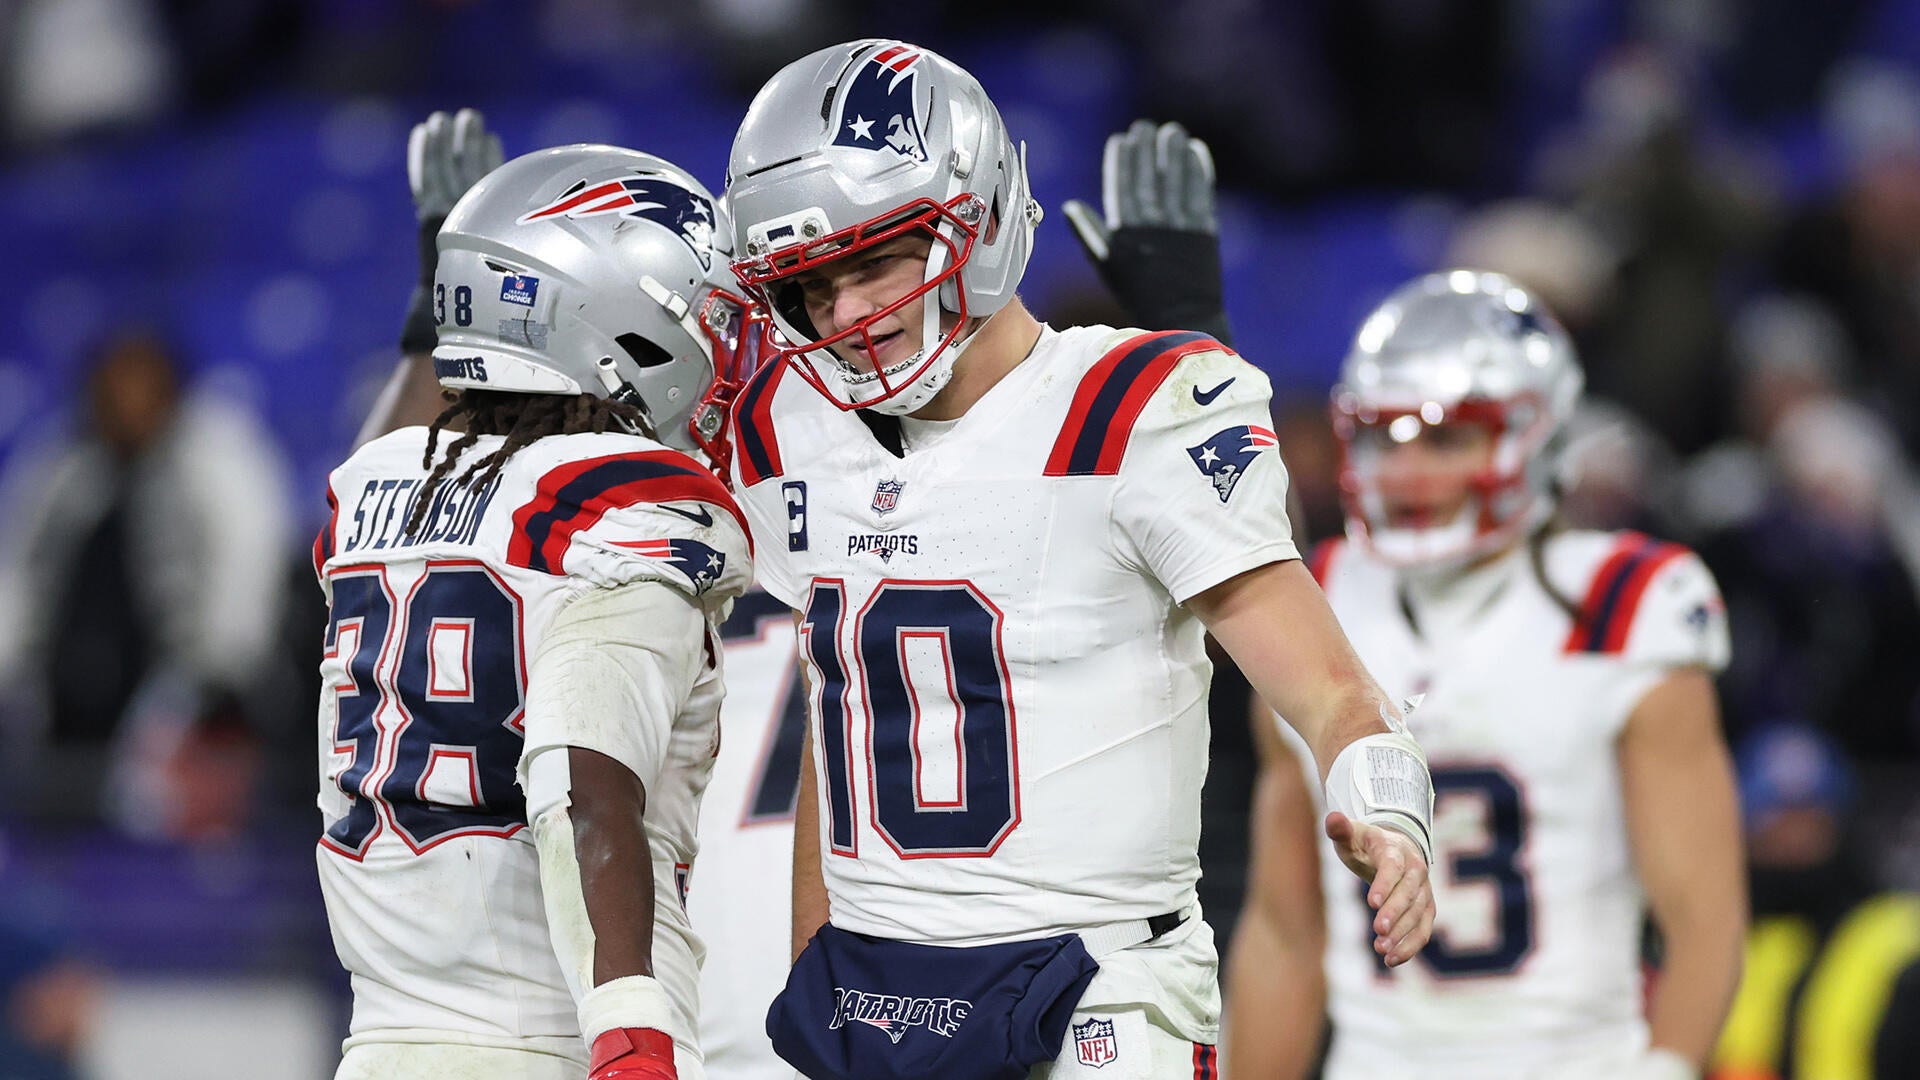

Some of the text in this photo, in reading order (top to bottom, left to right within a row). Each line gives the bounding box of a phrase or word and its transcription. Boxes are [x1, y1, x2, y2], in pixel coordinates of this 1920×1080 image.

[503, 292, 532, 304] CHANGE
[874, 493, 894, 509] NFL
[848, 534, 918, 557] PATRIOTS
[800, 577, 1022, 860] 10
[1080, 1038, 1114, 1063] NFL
